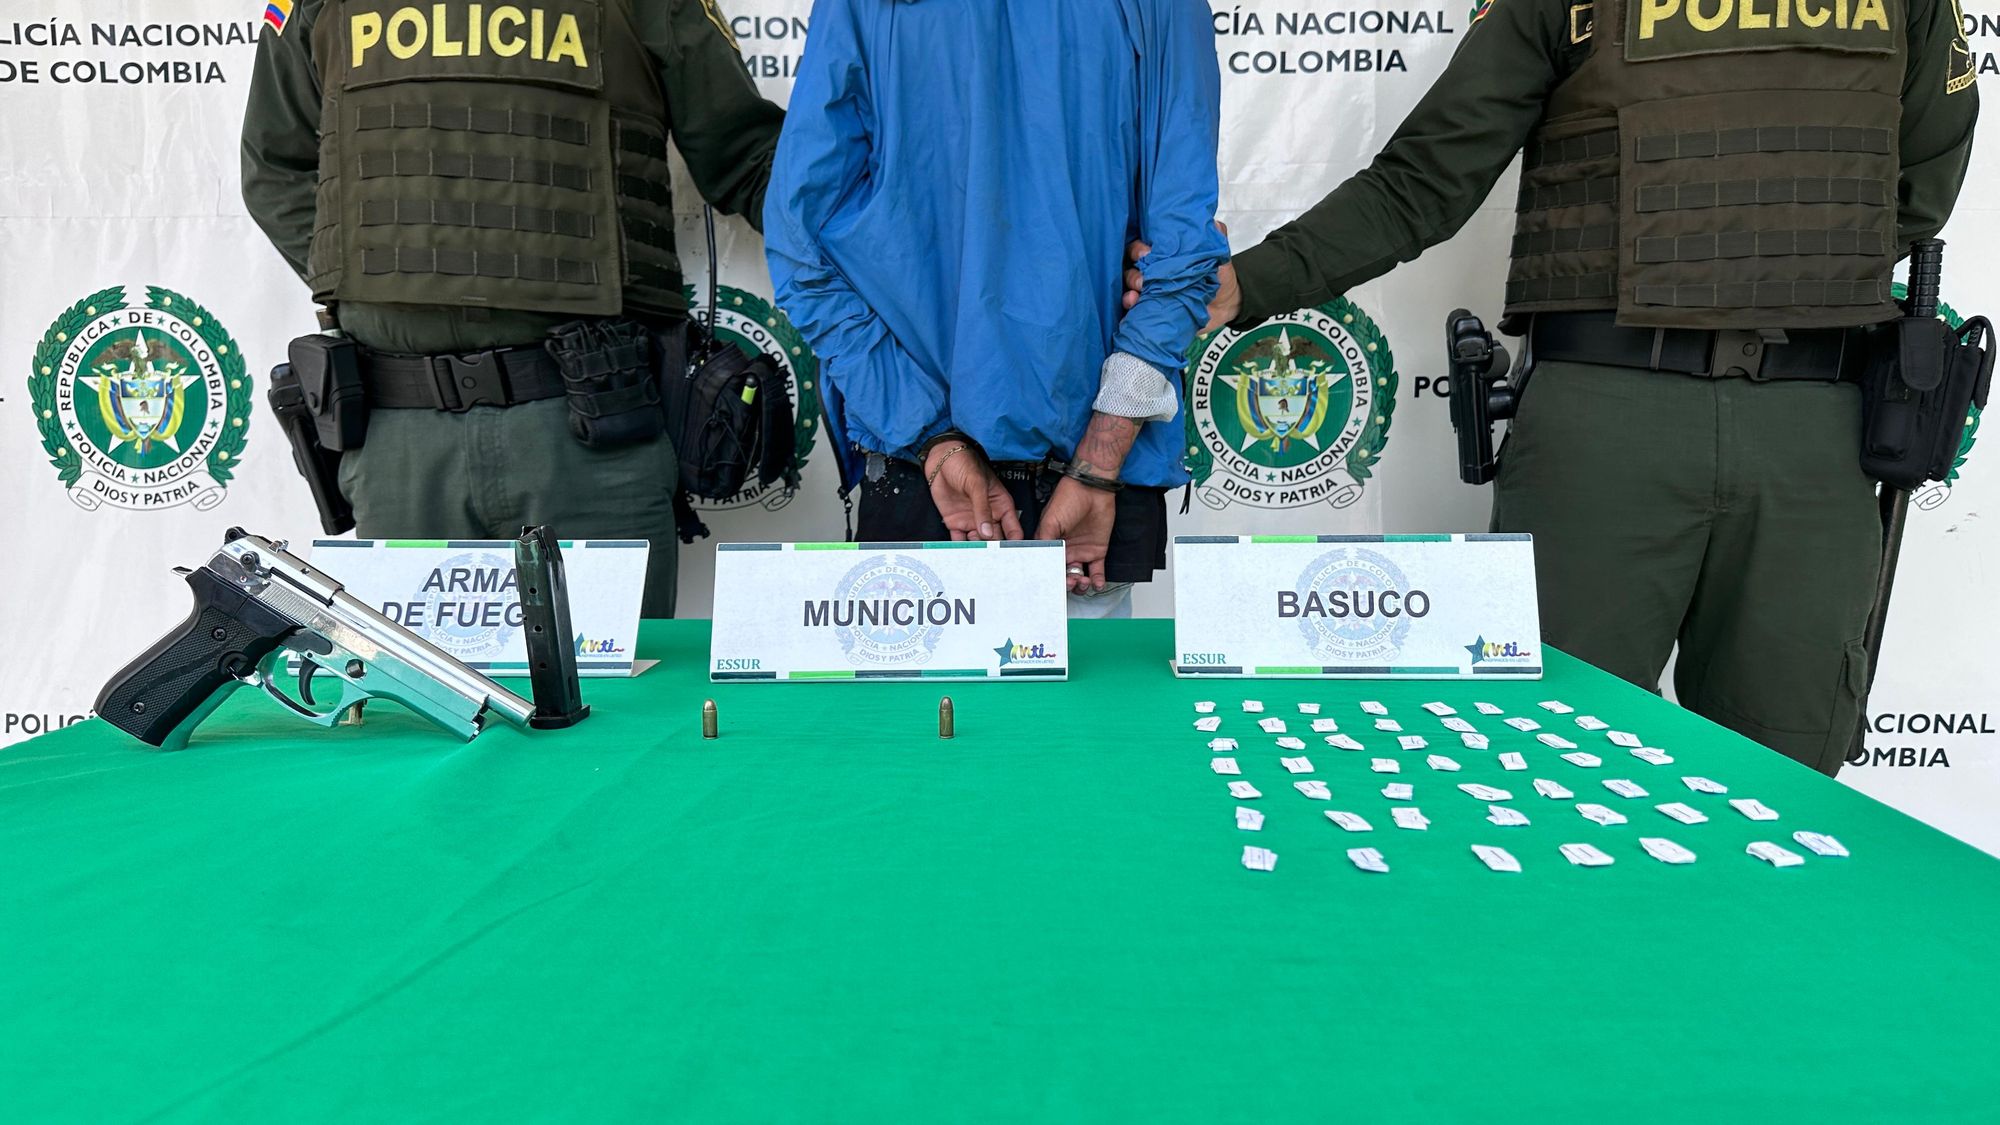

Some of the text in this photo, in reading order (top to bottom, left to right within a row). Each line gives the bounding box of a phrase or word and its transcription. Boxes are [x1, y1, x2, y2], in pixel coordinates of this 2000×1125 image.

[92, 21, 259, 47] NACIONAL
[351, 4, 588, 68] POLICIA
[1275, 10, 1454, 36] NACIONAL
[0, 60, 226, 84] DE COLOMBIA
[1229, 49, 1407, 74] COLOMBIA
[60, 312, 223, 410] REPÚBLICA DE COLOMBIA
[1317, 318, 1368, 408] COLOMBIA
[144, 430, 217, 484] NACIONAL
[1281, 429, 1360, 483] NACIONAL
[144, 480, 200, 505] PATRIA
[1280, 478, 1338, 504] PATRIA
[422, 568, 519, 592] ARMA
[382, 602, 526, 627] DE FUEG
[803, 592, 976, 627] MUNICIÓN
[1277, 590, 1430, 619] BASUCO
[716, 658, 761, 670] ESSUR
[1183, 653, 1226, 665] ESSUR
